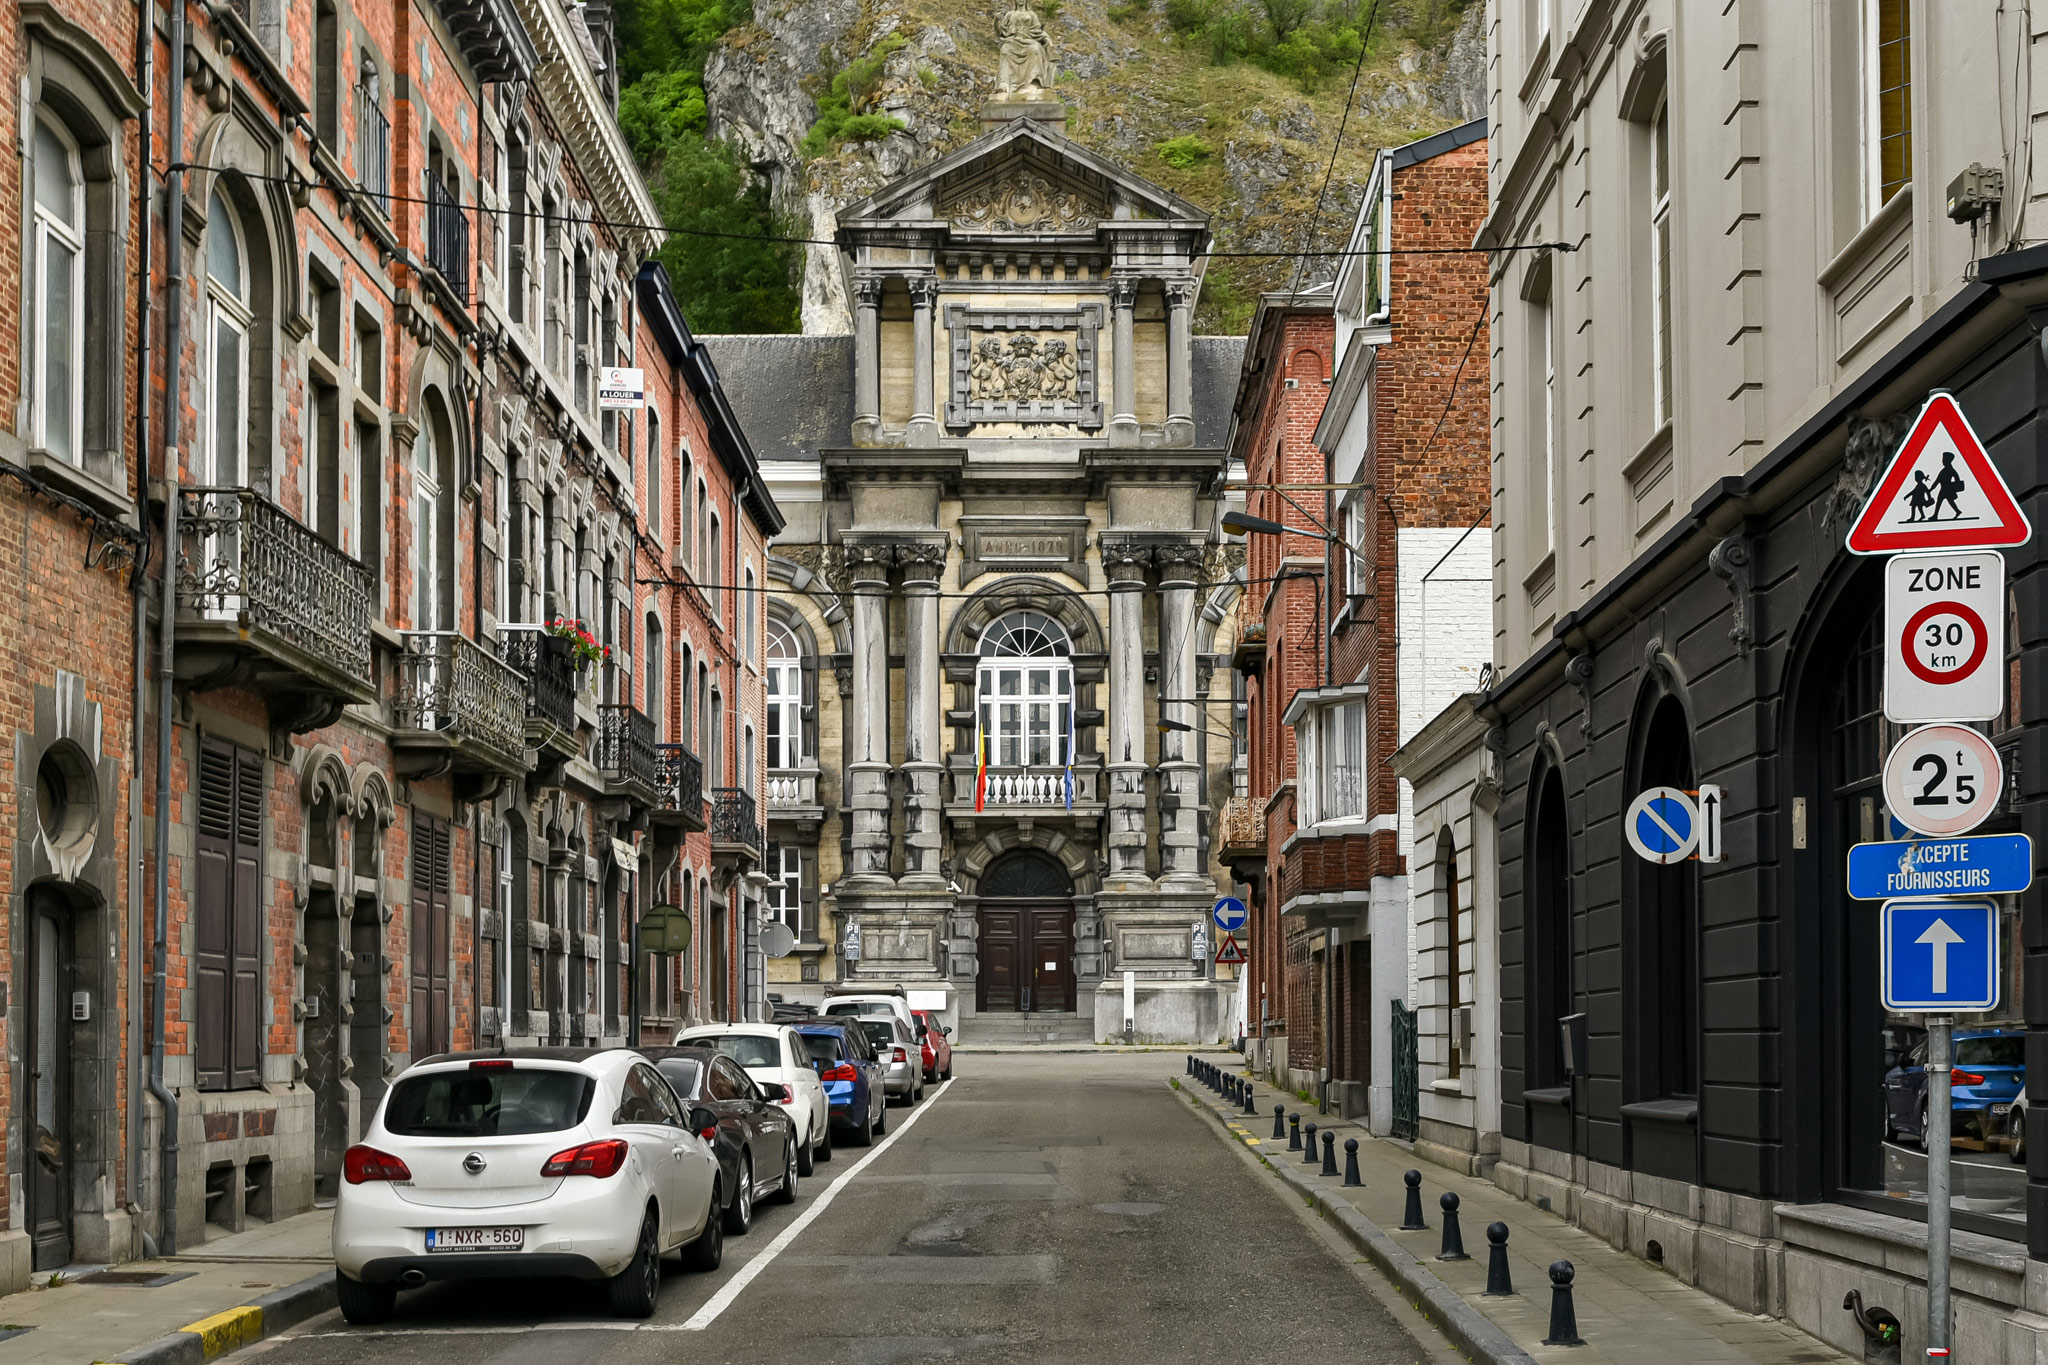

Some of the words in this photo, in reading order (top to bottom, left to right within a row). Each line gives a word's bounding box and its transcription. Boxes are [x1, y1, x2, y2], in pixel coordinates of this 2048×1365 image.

[1908, 565, 1981, 592] ZONE
[1925, 623, 1963, 647] 30
[1931, 653, 1956, 667] km
[1887, 868, 1990, 891] FOURNISSEURS
